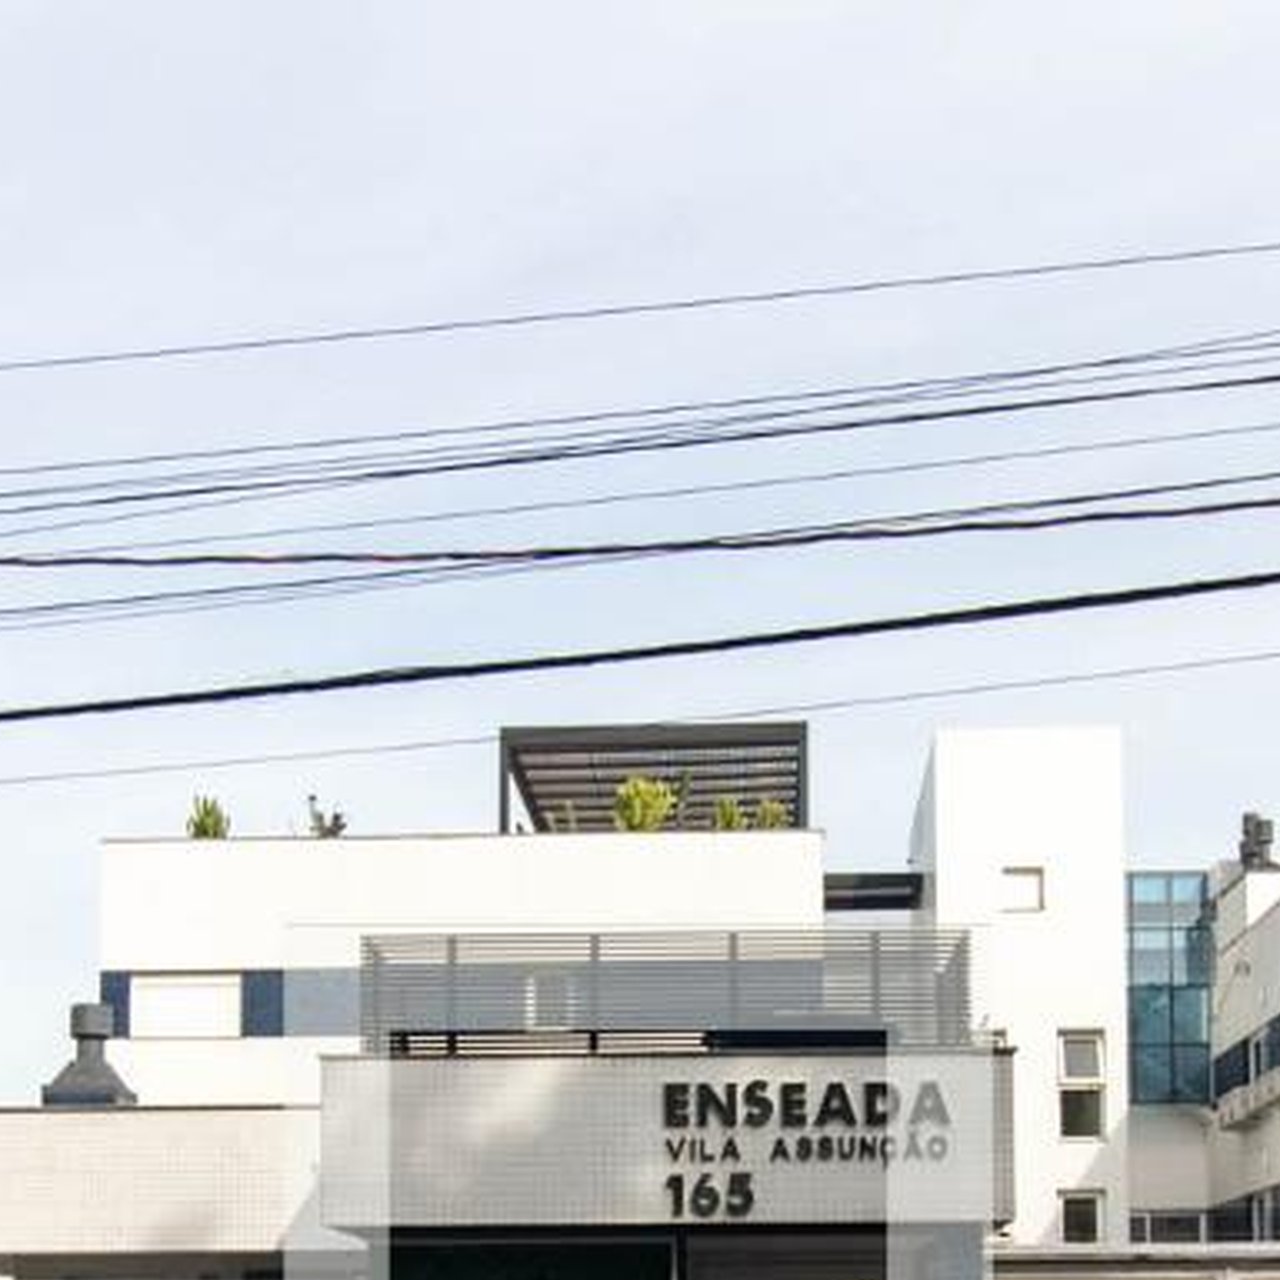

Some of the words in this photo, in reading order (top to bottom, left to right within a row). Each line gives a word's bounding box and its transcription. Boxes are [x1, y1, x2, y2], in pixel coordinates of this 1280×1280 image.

[663, 1081, 950, 1128] ENSEADA
[666, 1137, 741, 1162] VILA
[665, 1173, 755, 1218] 165
